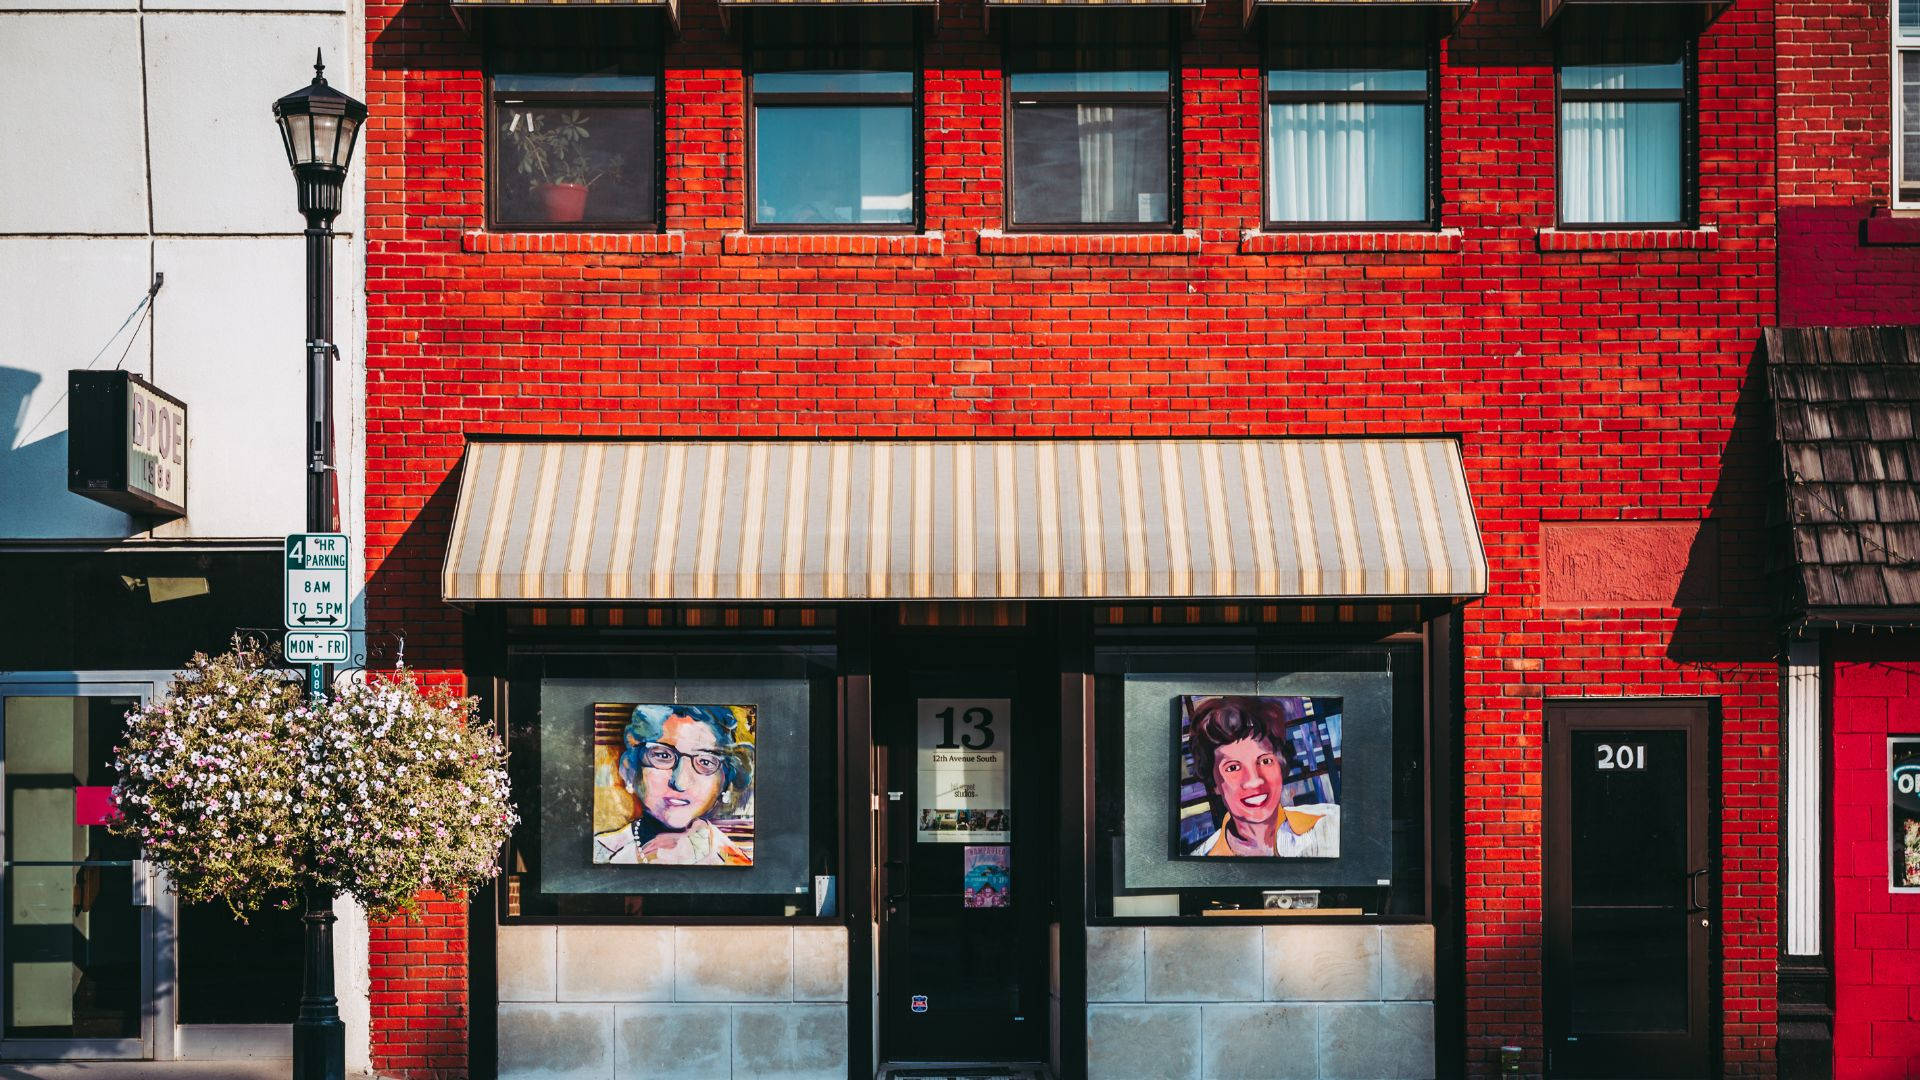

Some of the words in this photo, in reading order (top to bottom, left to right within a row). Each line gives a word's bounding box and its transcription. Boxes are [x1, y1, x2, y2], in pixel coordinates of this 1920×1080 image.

[133, 392, 182, 466] BPOE
[288, 541, 304, 564] 4
[319, 539, 335, 551] HR
[306, 554, 345, 567] PARKING
[292, 602, 307, 615] TO
[290, 639, 314, 654] MON
[327, 639, 345, 654] FRI
[935, 706, 995, 750] 13
[932, 755, 948, 763] 12th
[949, 755, 975, 763] Avenue
[976, 755, 997, 763] South
[1597, 744, 1644, 769] 201
